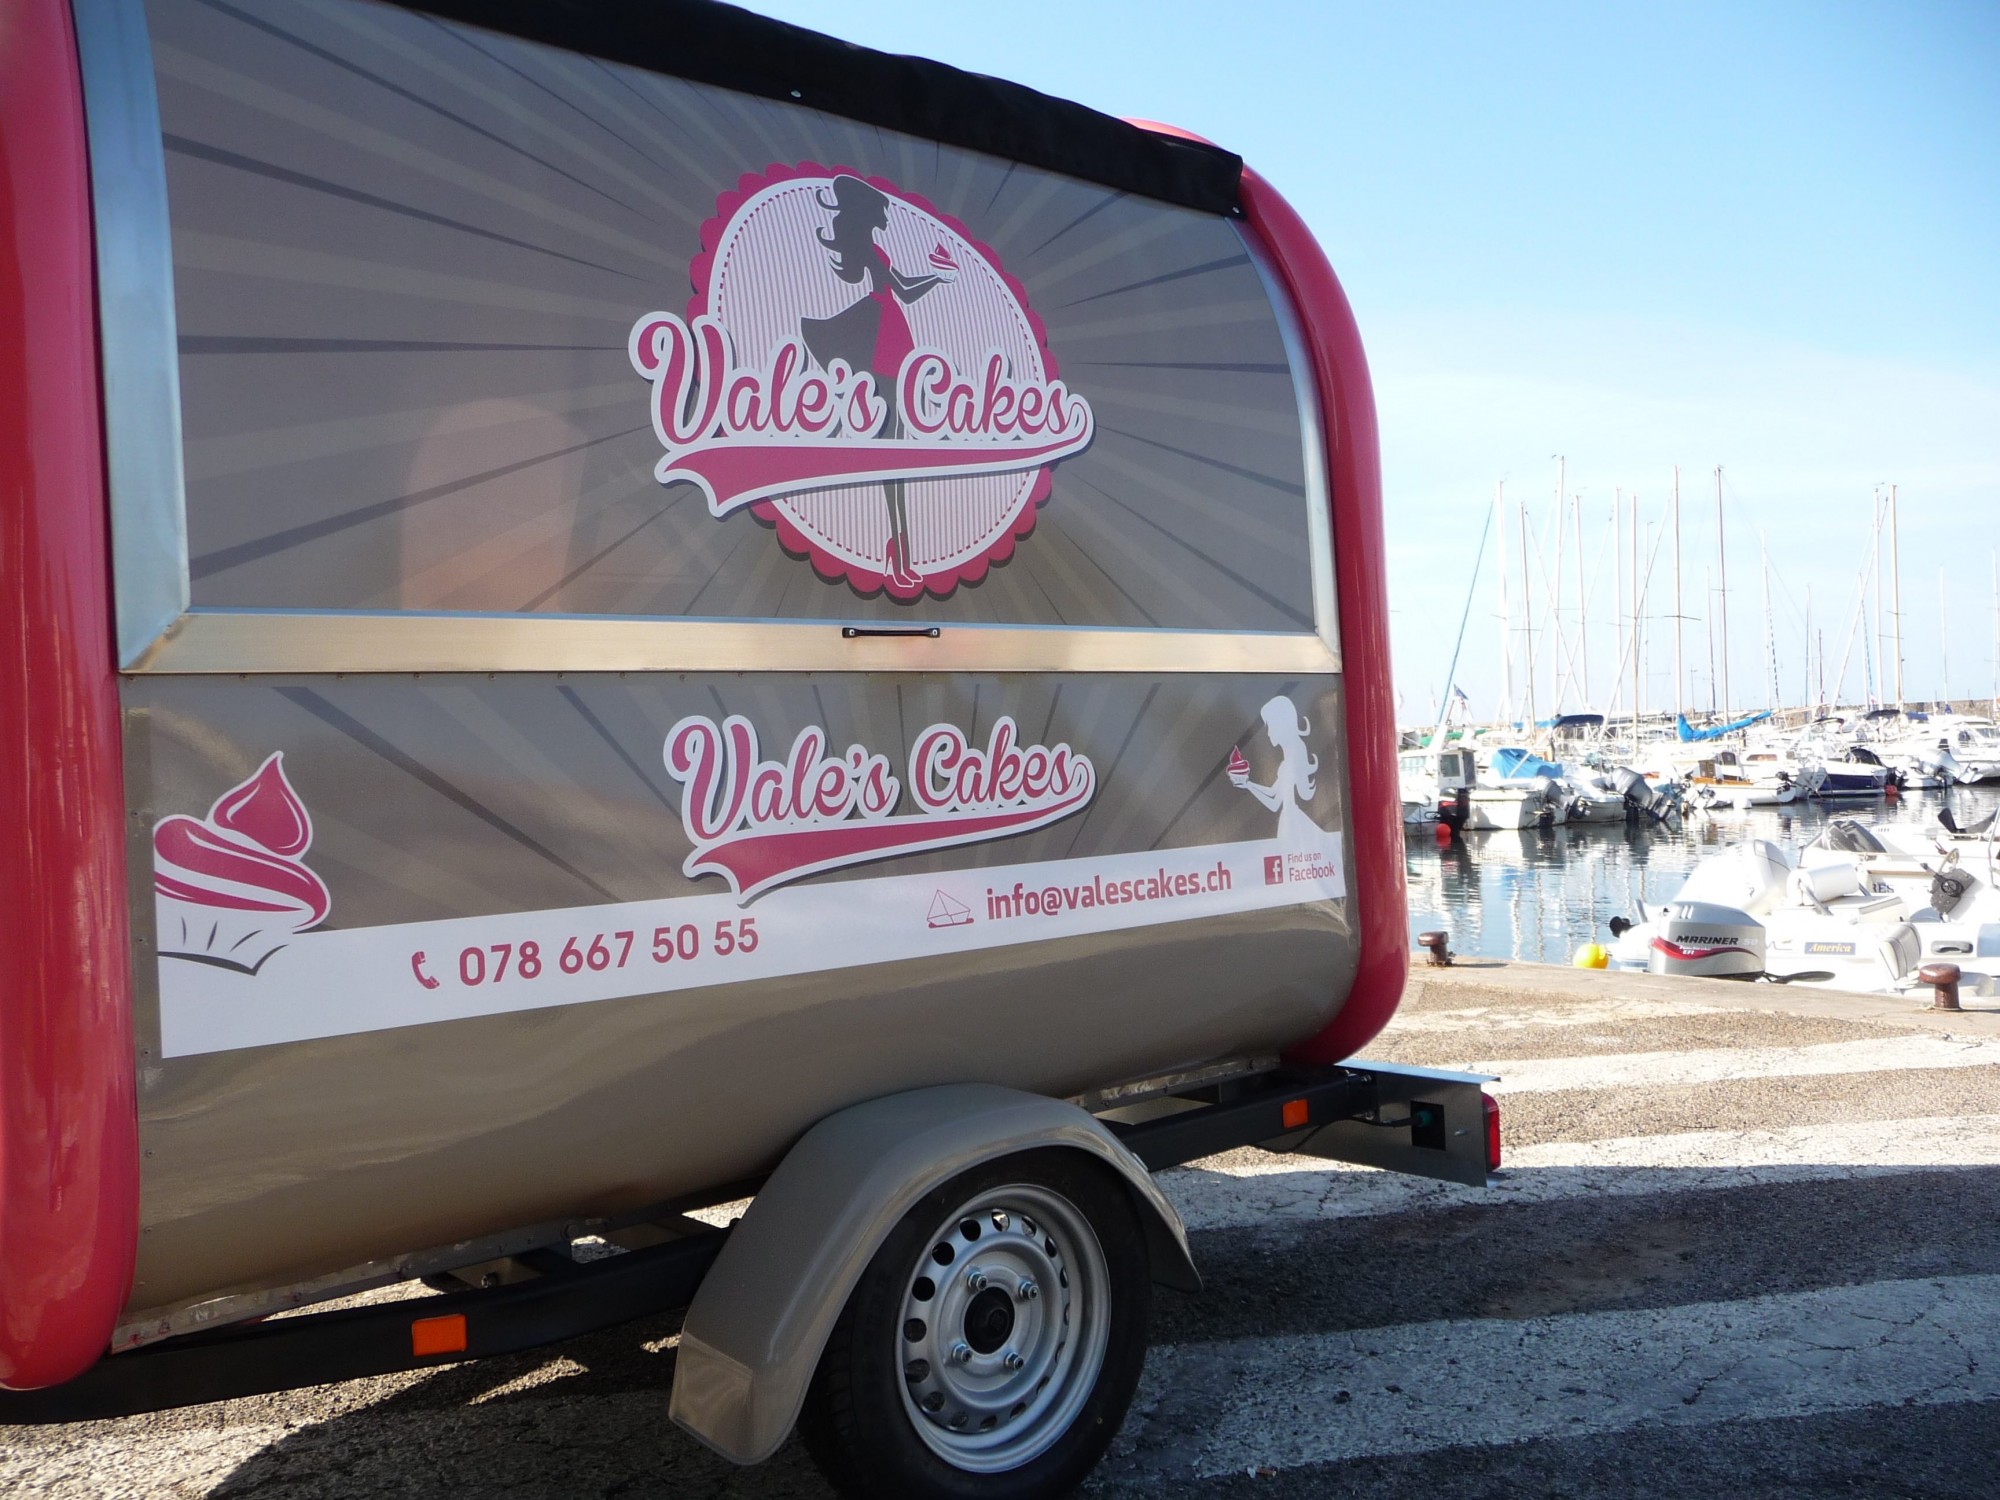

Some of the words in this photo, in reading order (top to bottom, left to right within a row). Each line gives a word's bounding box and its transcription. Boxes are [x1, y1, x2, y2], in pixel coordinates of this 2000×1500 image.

[633, 315, 885, 447] Vale's
[901, 350, 1084, 437] Cakes
[668, 719, 896, 841] Vale's
[913, 720, 1086, 809] Cakes
[1287, 852, 1303, 864] Find
[1304, 853, 1312, 862] us
[1313, 852, 1322, 861] on
[1288, 861, 1336, 882] Facebook
[986, 861, 1232, 920] info@valescakes.ch
[458, 940, 542, 987] 078
[559, 931, 634, 975] 667
[652, 923, 700, 964] 50
[713, 917, 759, 956] 55
[1675, 935, 1739, 945] MARINER
[1809, 943, 1851, 953] America
